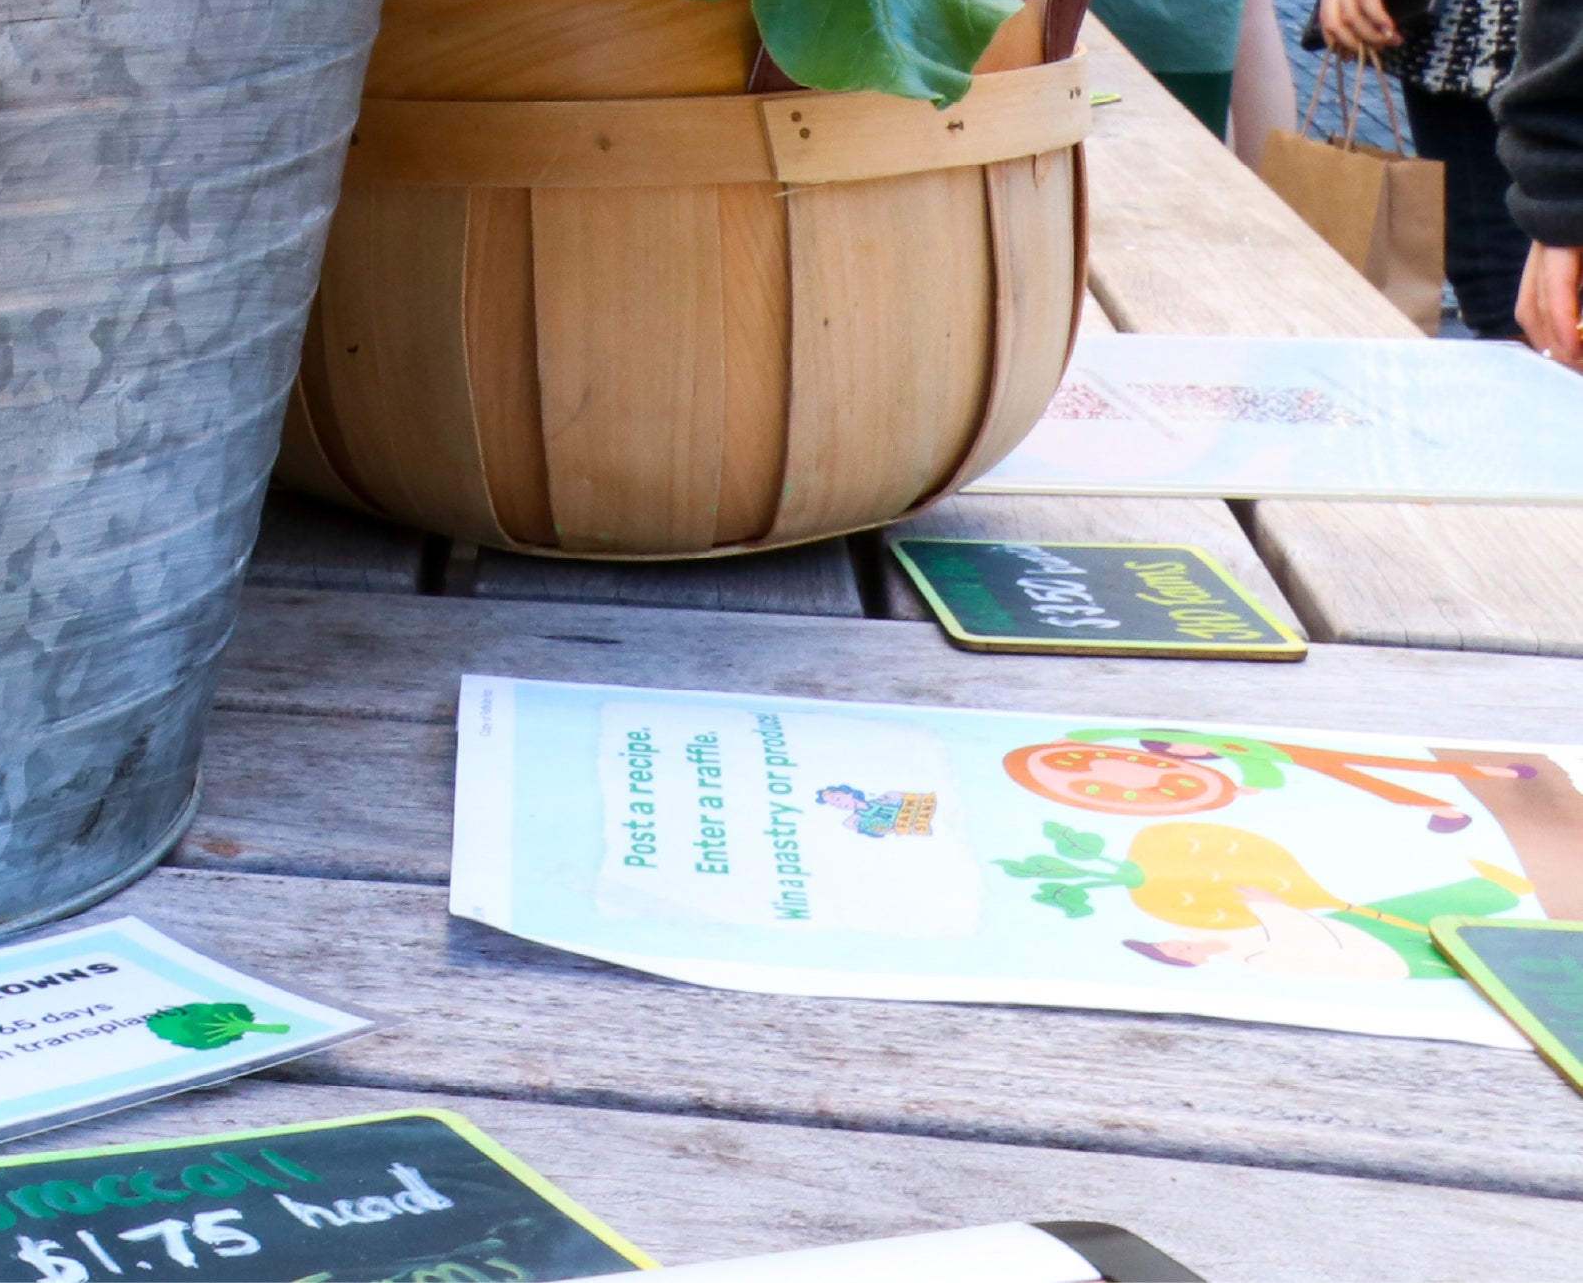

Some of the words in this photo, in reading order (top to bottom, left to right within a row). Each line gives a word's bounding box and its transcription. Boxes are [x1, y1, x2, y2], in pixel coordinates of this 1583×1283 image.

[747, 711, 798, 767] produce!
[617, 727, 661, 795] recipe.
[686, 730, 723, 789] raffle.
[766, 771, 792, 795] or
[629, 801, 655, 816] a
[698, 795, 724, 810] a
[896, 799, 916, 828] FARM
[914, 796, 935, 832] STAND
[621, 819, 659, 868] Post
[692, 814, 729, 875] Enter
[763, 801, 812, 877] pastry
[778, 878, 805, 889] a
[771, 891, 812, 920] Win
[40, 1002, 114, 1024] days
[13, 1207, 263, 1283] $1.75
[273, 1161, 455, 1230] head
